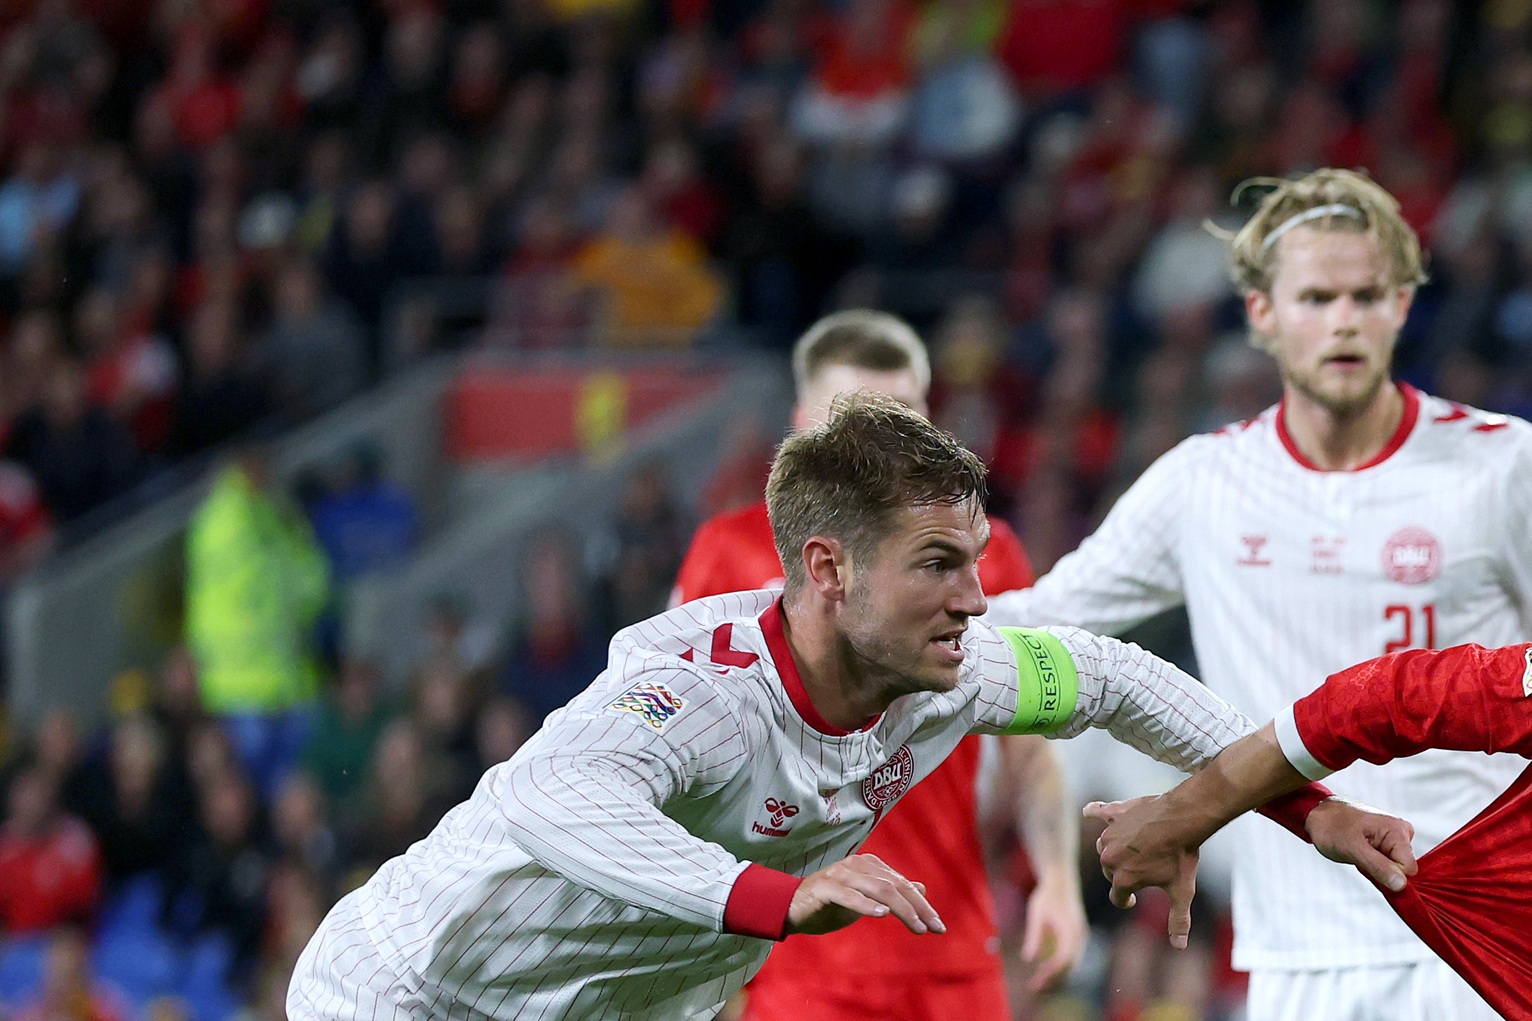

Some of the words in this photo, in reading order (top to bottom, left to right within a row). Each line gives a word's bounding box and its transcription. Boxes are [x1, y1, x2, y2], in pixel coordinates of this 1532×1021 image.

[1385, 604, 1435, 656] 21
[1020, 633, 1057, 711] RESPECT
[873, 763, 901, 790] DBU
